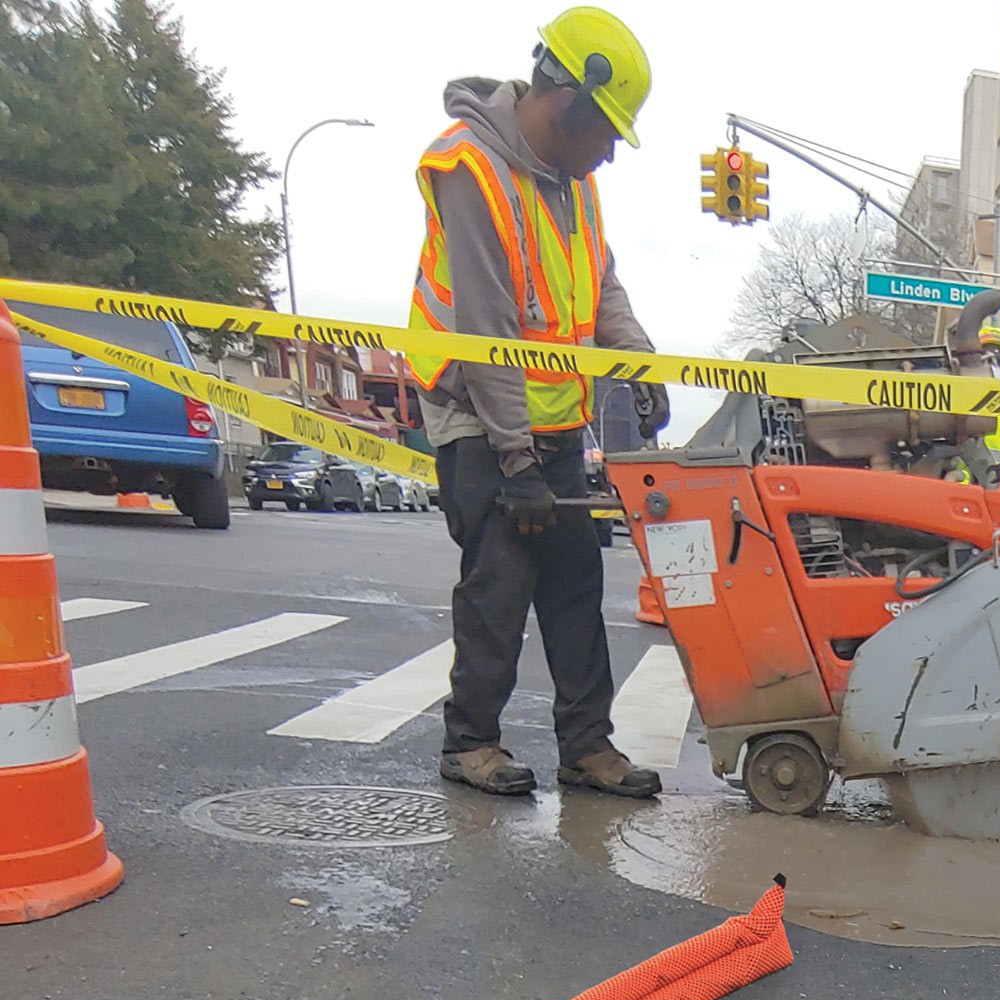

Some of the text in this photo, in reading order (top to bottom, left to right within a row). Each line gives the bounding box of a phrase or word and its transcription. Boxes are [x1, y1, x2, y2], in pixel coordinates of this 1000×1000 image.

[890, 280, 976, 303] Linden Blv
[489, 346, 578, 373] CAUTION
[681, 365, 767, 395] CAUTION
[867, 379, 951, 411] CAUTION
